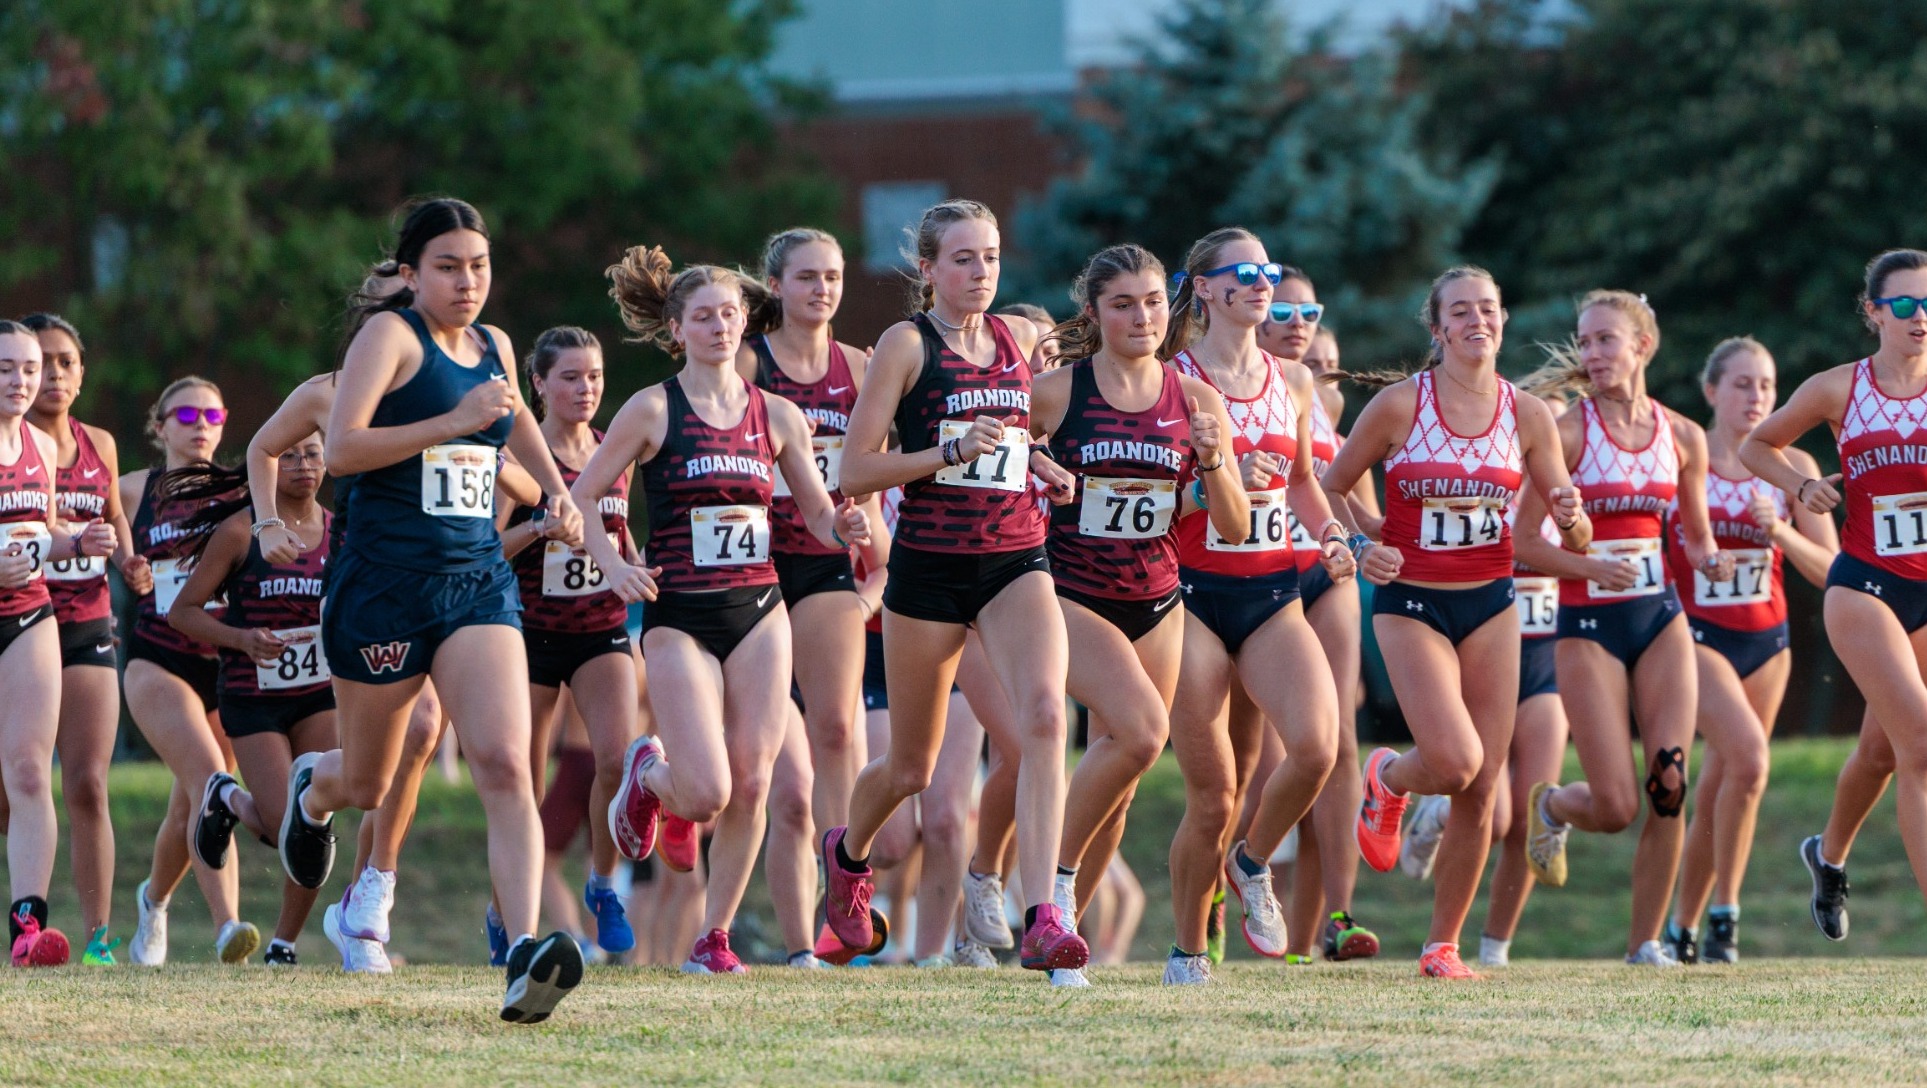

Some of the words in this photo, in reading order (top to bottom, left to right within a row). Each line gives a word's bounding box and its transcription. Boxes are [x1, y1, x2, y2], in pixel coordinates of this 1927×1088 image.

[946, 388, 1031, 415] ROANOKE
[686, 455, 770, 483] ROANOKE
[1080, 440, 1182, 473] ROANOKE
[0, 490, 48, 513] ANOKE
[434, 467, 492, 510] 158
[1104, 496, 1156, 534] 76
[1216, 507, 1283, 546] 16
[1430, 507, 1498, 547] 114
[713, 523, 757, 560] 74
[563, 558, 604, 590] 85
[277, 643, 319, 681] 84
